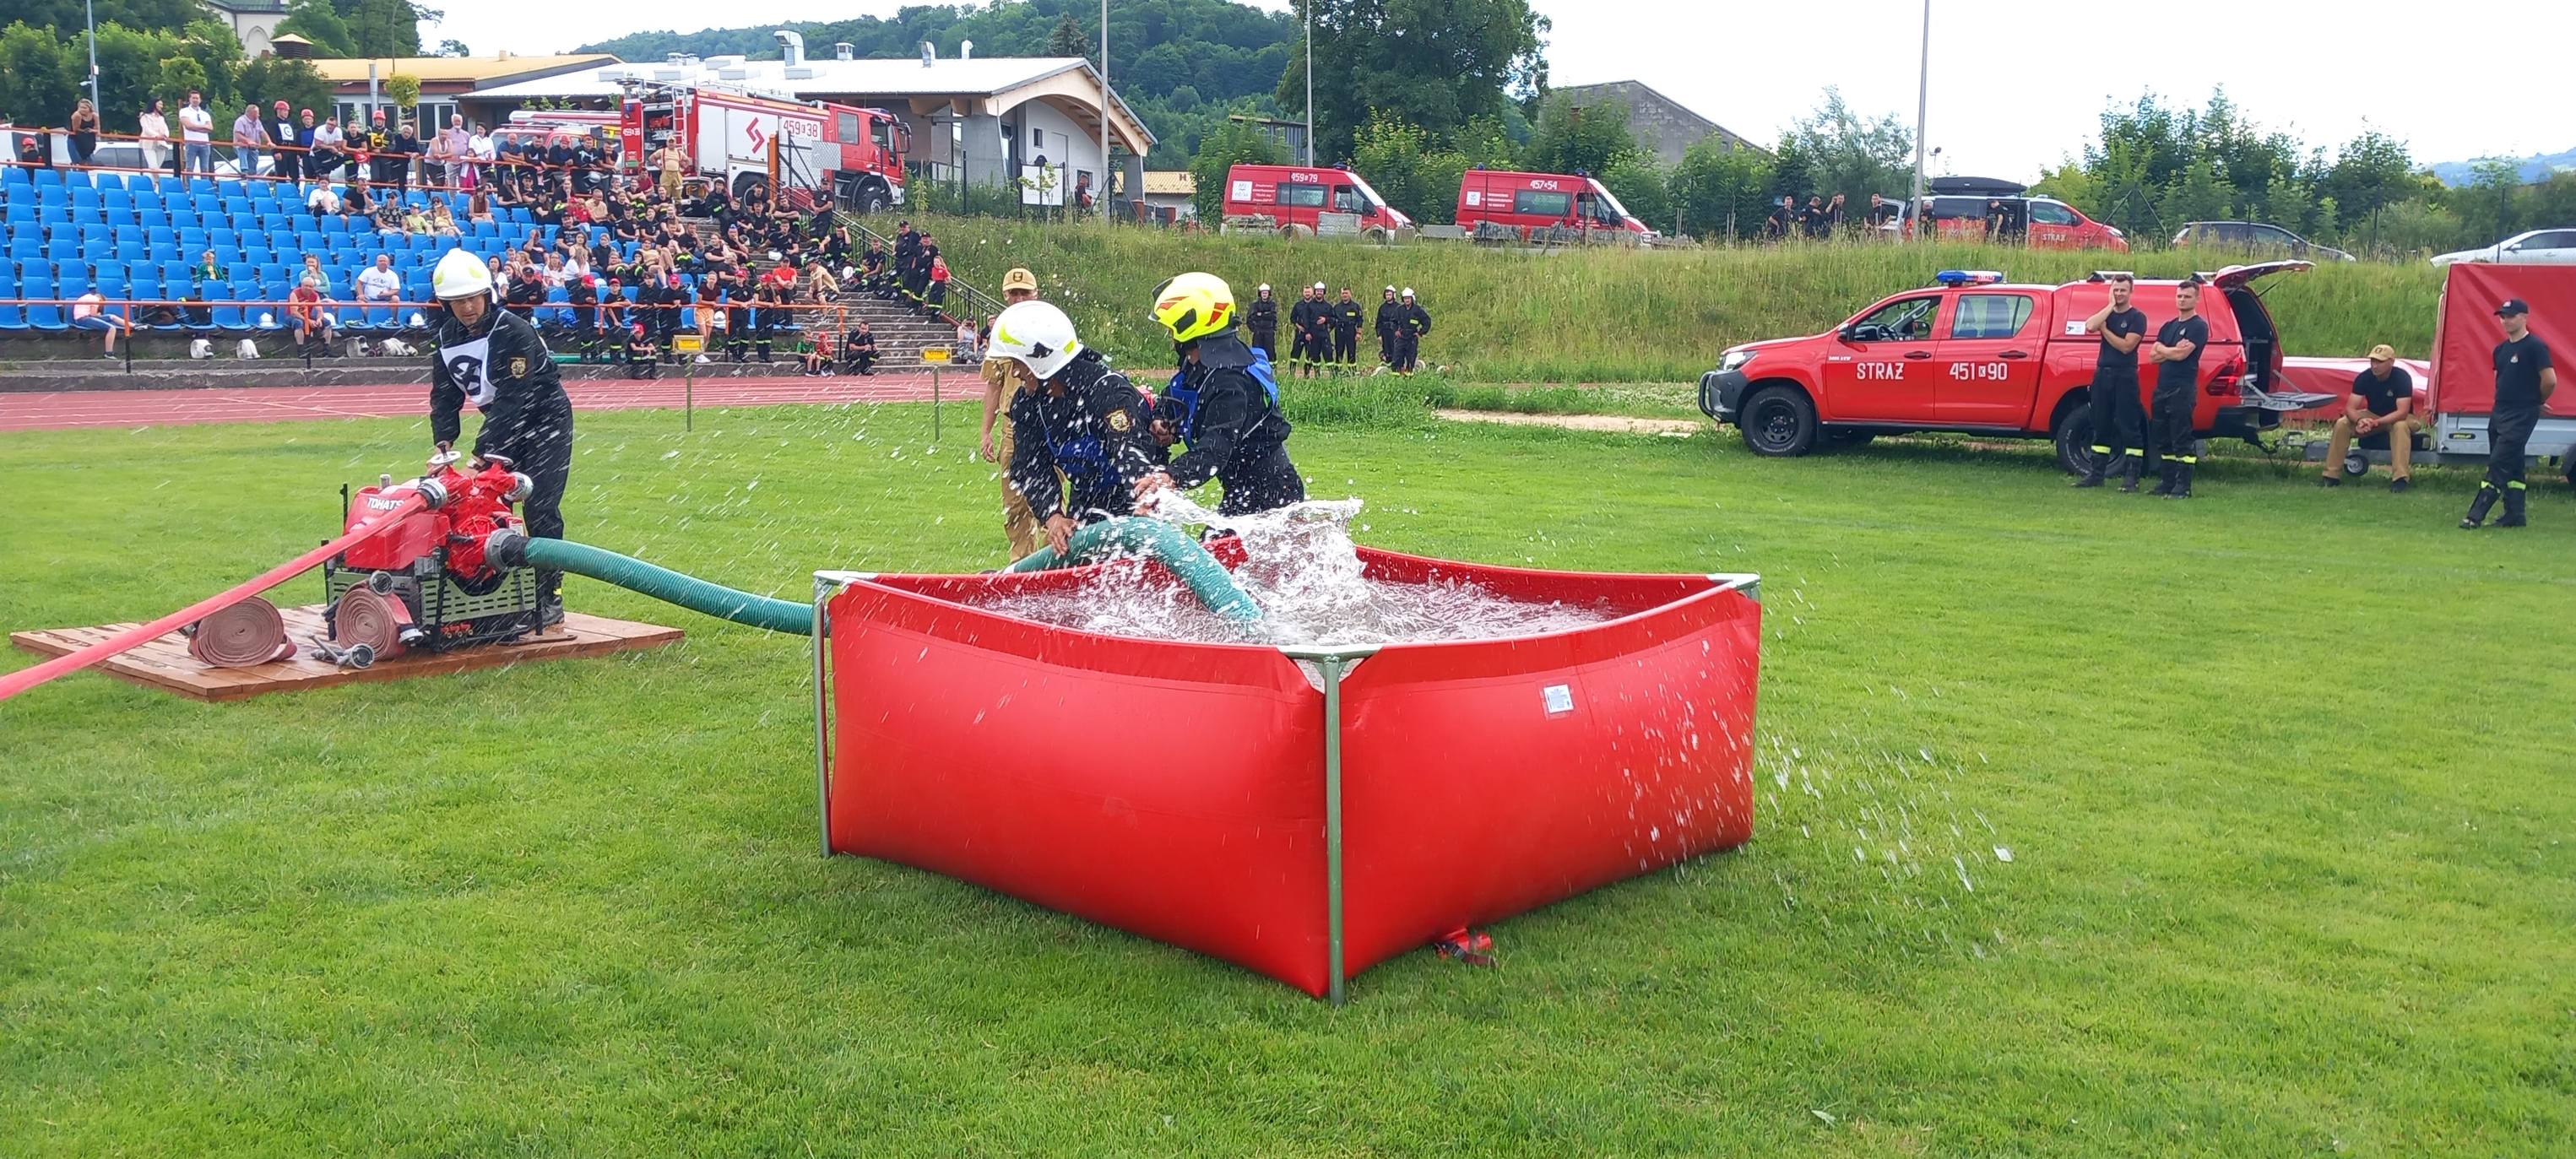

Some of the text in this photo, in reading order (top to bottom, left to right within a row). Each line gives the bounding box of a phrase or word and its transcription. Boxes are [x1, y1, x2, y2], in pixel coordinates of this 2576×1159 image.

[1291, 172, 1318, 182] 45979
[1530, 180, 1558, 190] 45754
[367, 497, 404, 511] TOHATS
